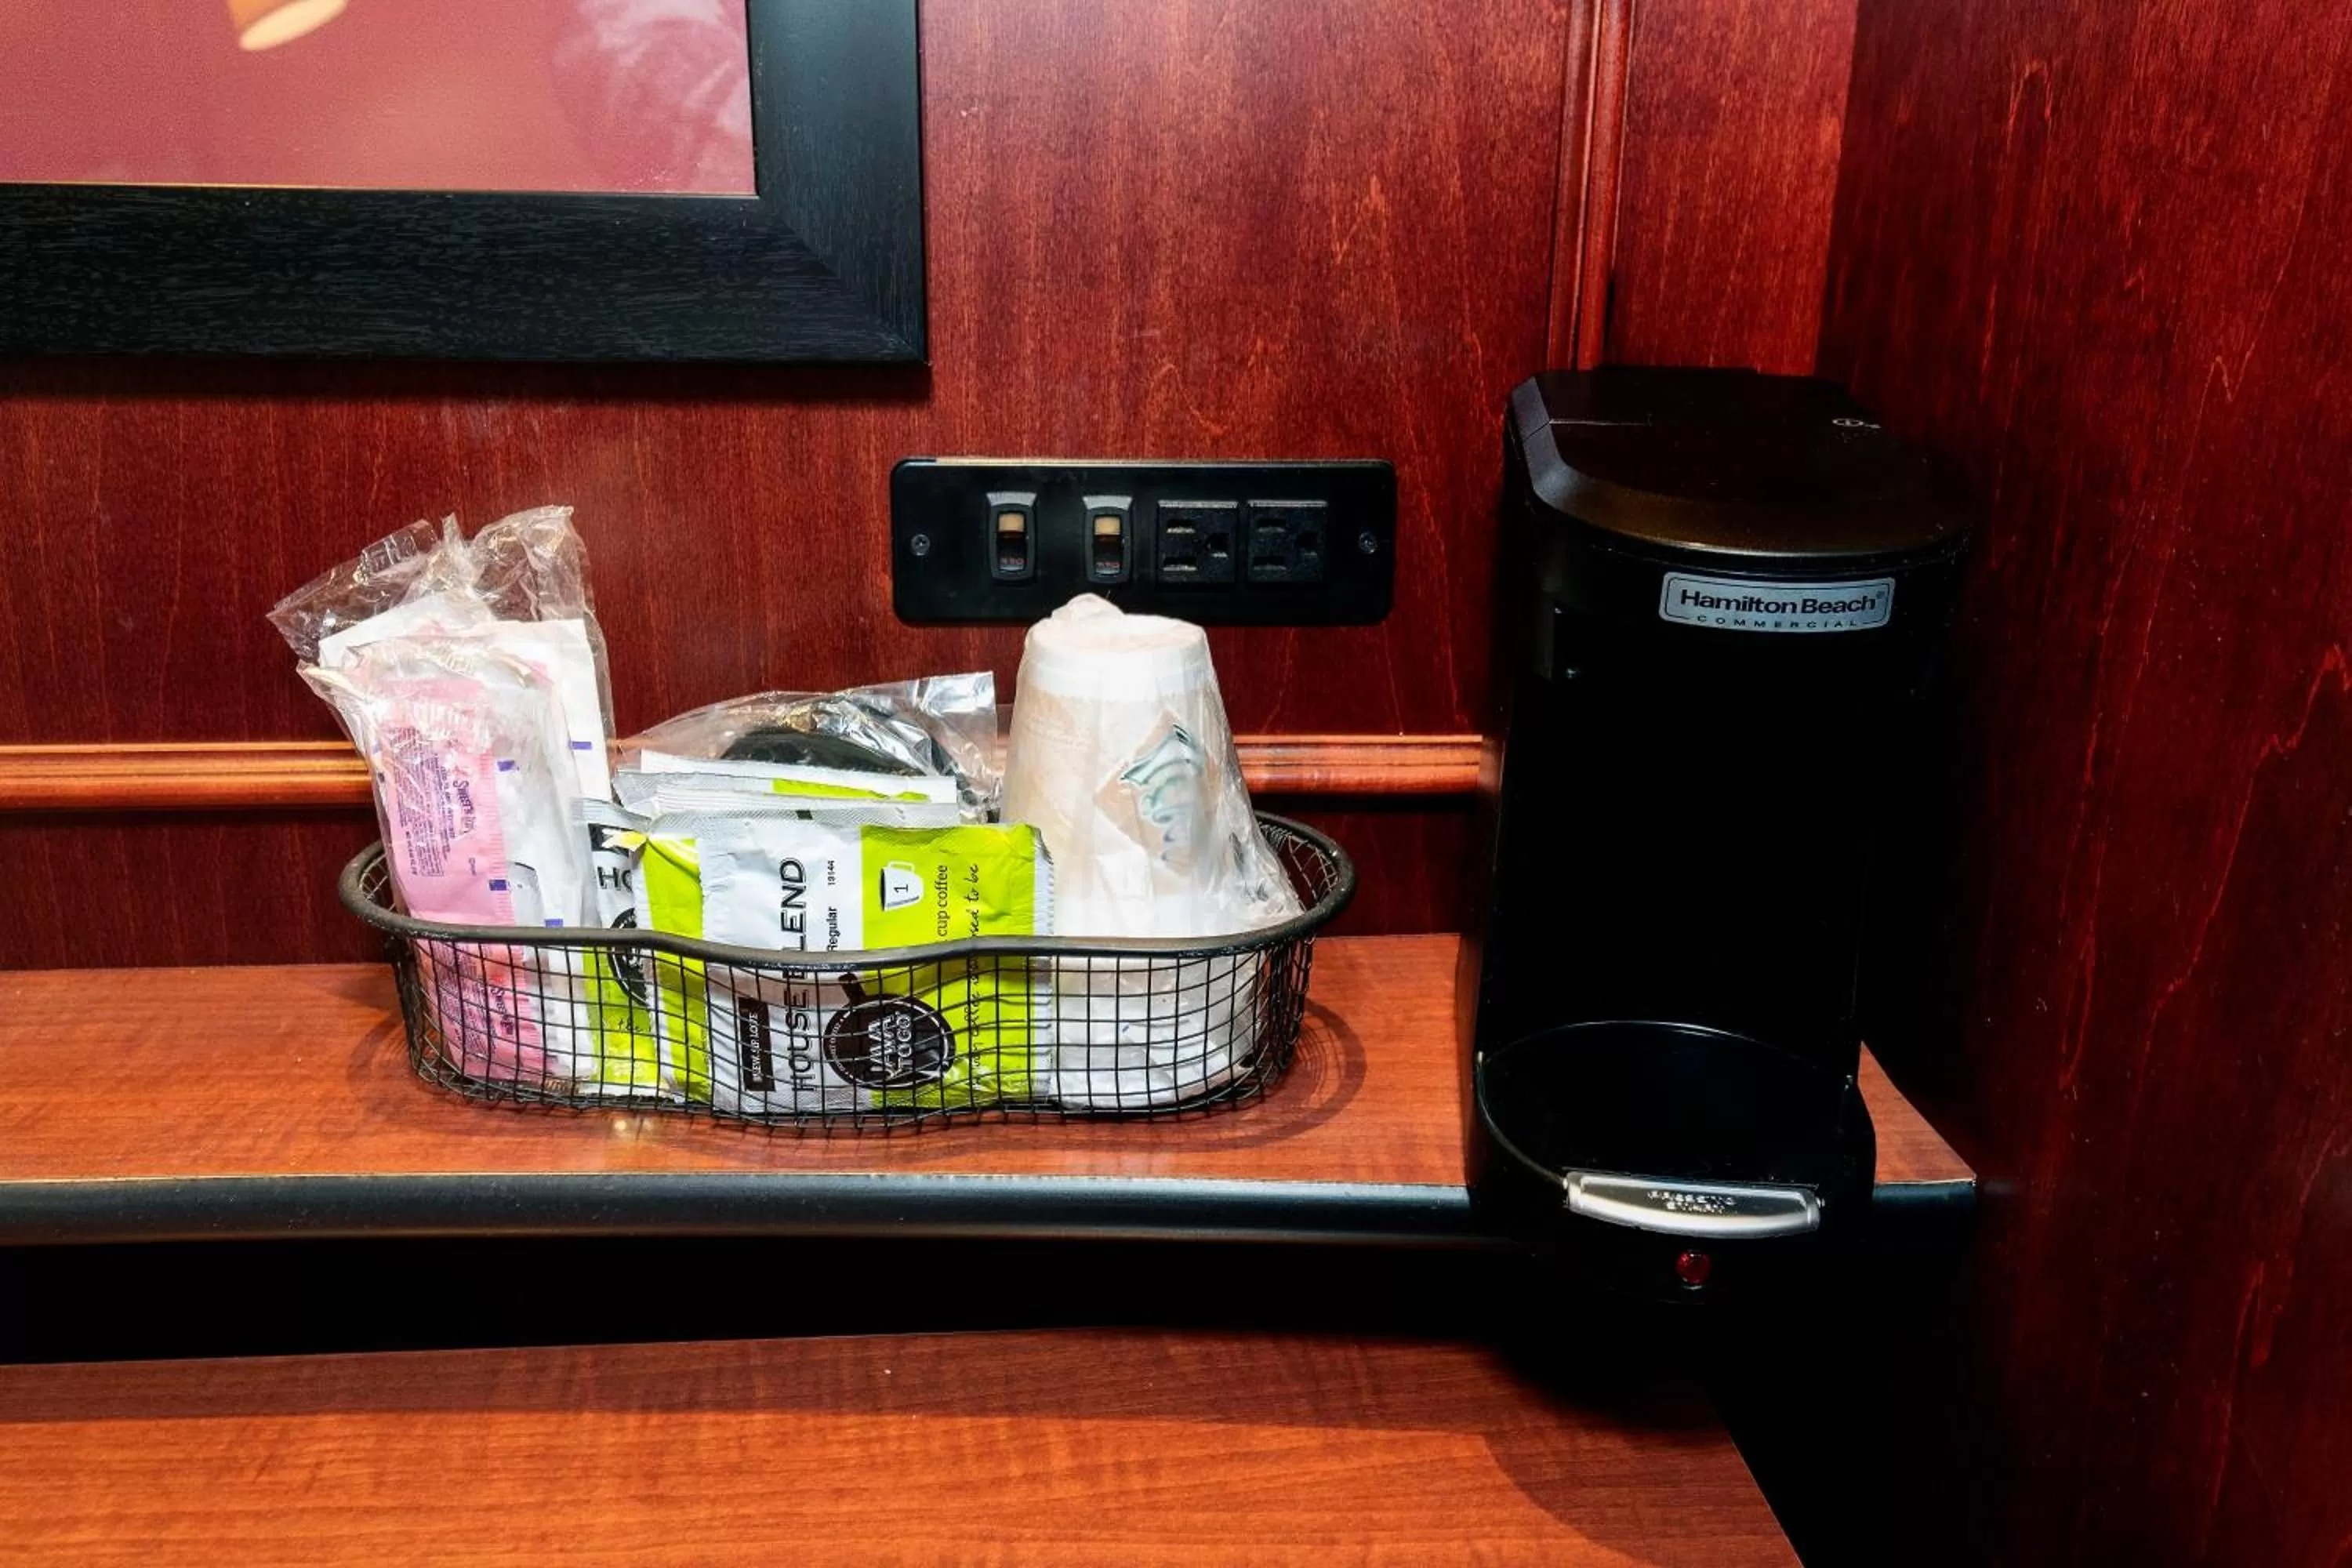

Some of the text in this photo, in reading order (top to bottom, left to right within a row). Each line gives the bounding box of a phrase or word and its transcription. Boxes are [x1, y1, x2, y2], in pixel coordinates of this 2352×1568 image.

[1680, 589, 1876, 615] Hamilton Beach
[1697, 615, 1858, 628] COMMERCIAL
[963, 863, 979, 884] be
[893, 884, 909, 894] 1
[935, 865, 949, 937] cup coffee
[826, 906, 841, 951] Regular
[784, 989, 817, 1092] HOUSE
